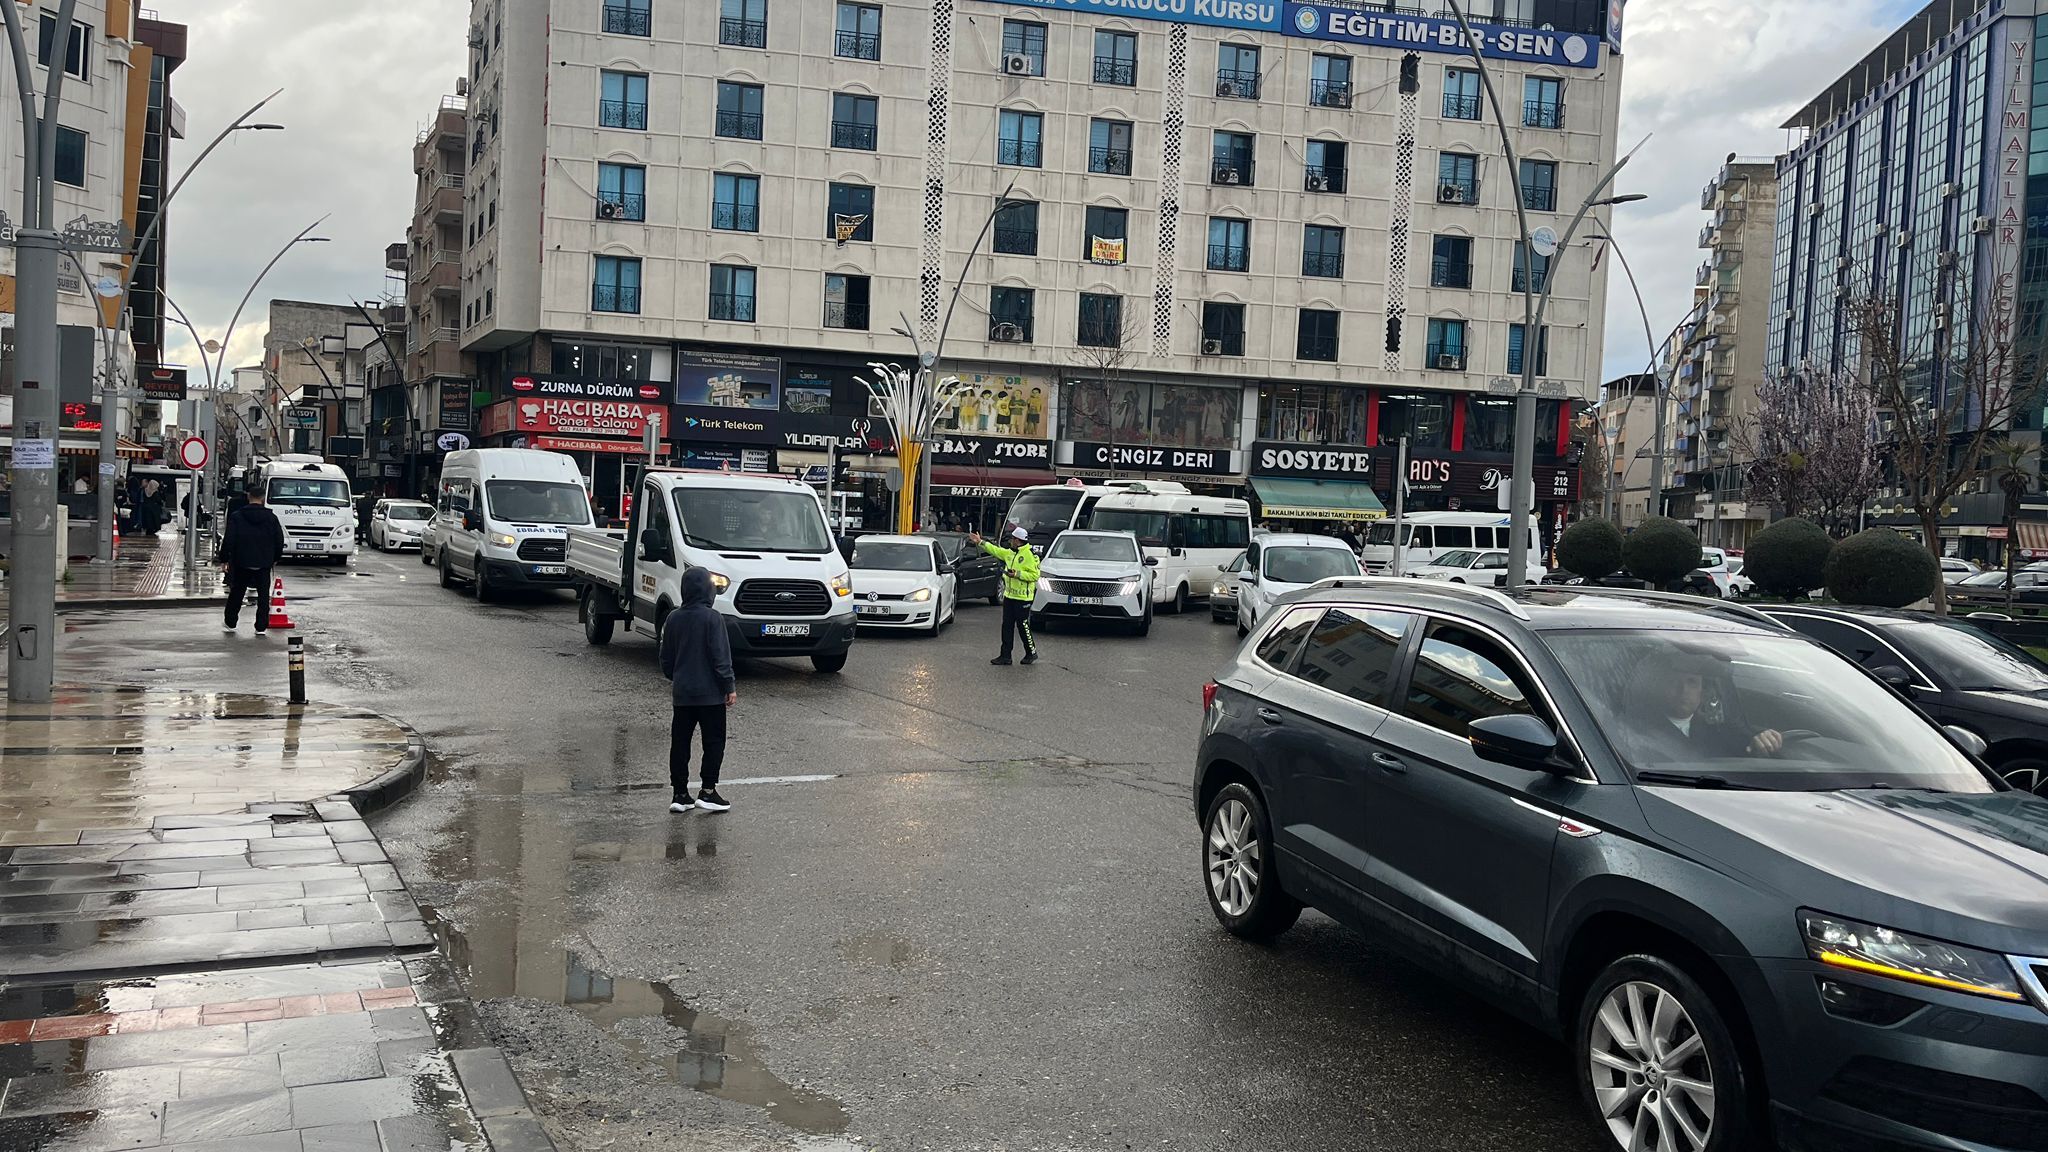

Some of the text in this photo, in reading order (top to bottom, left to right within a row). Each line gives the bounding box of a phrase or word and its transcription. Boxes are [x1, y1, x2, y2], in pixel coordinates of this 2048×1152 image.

[1193, 0, 1274, 23] KURSU
[2002, 41, 2027, 245] YILMAZLAR
[540, 381, 583, 394] ZURNA
[587, 383, 634, 397] DÜRÜM
[543, 400, 644, 419] HACIBABA
[549, 415, 638, 429] Döner Salonu
[700, 418, 764, 431] Türk Telekom
[557, 440, 603, 450] HACIBABA
[995, 443, 1048, 458] STORE
[1096, 446, 1214, 468] CENGİZ DERİ
[1261, 449, 1370, 472] SOSYETE
[1410, 459, 1450, 482] AO'S
[1554, 476, 1568, 486] 212
[951, 487, 1003, 497] BAY STORE
[765, 624, 809, 634] 33 ARK 275
